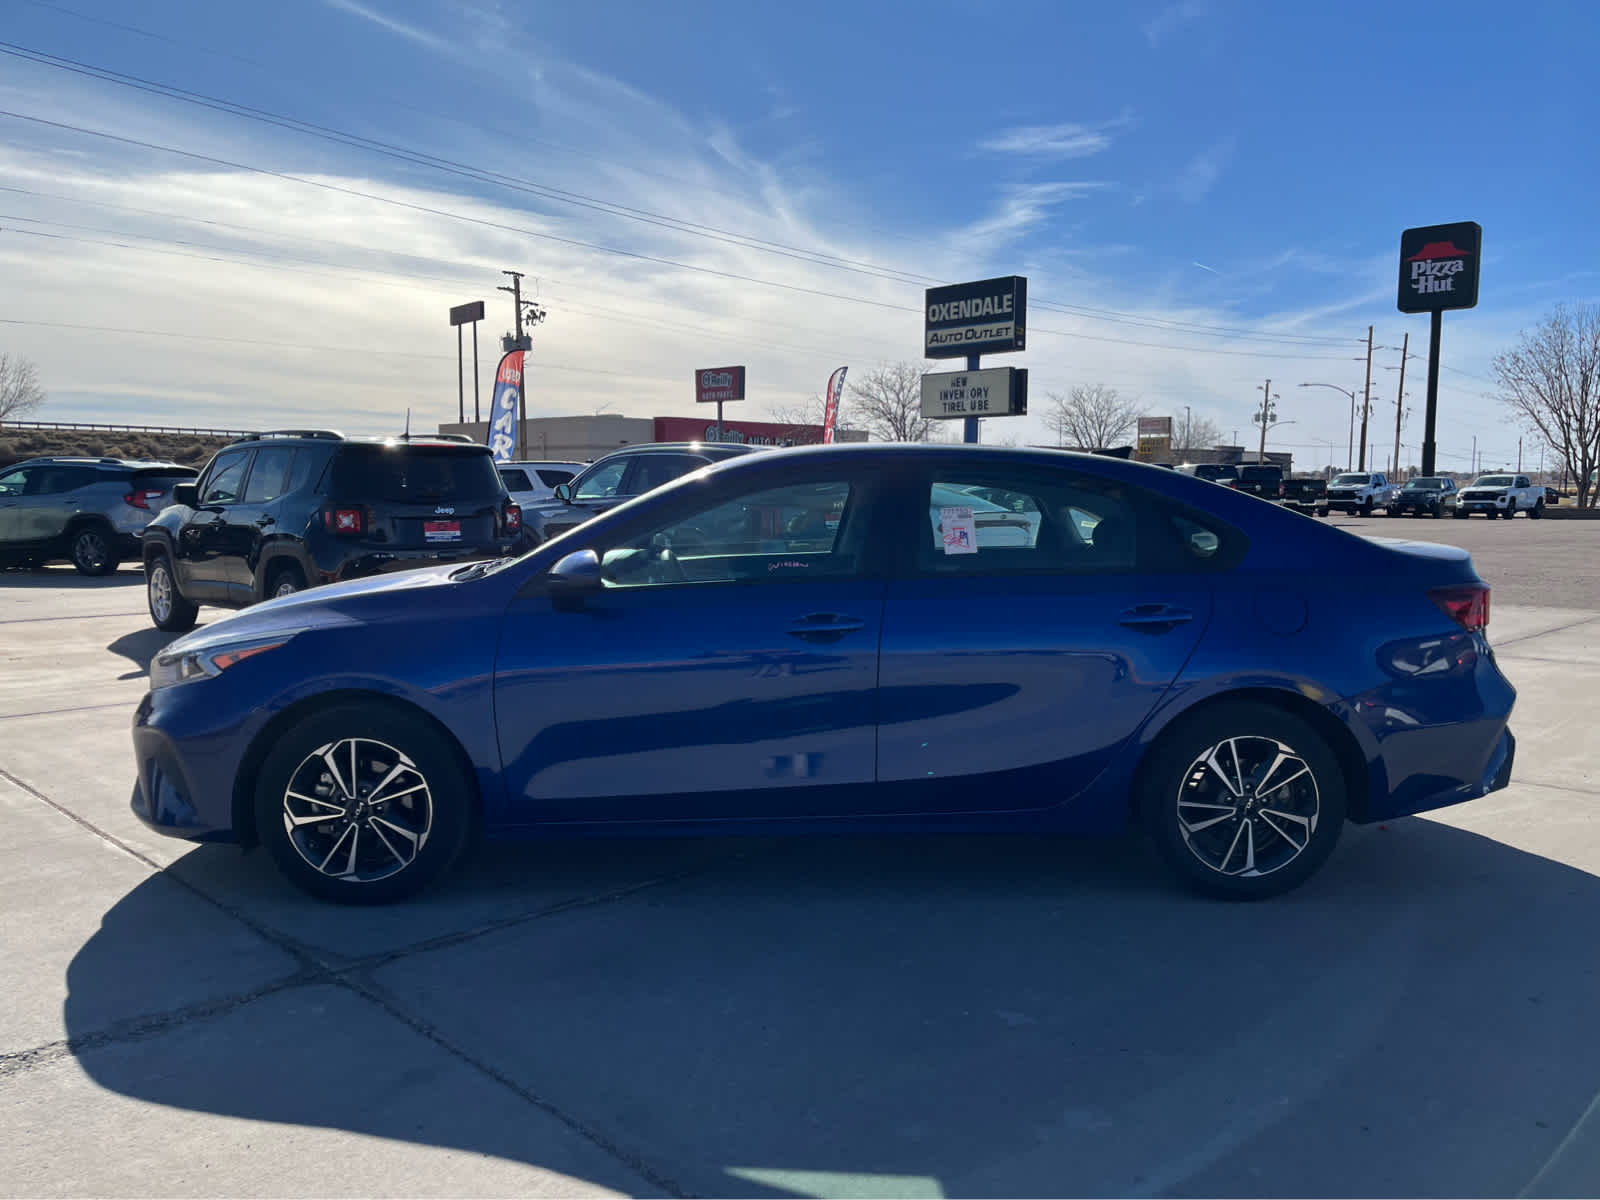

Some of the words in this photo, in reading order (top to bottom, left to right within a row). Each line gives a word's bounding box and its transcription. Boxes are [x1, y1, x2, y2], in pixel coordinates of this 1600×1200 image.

[1411, 259, 1464, 279] Pizza
[1411, 275, 1456, 294] Hut
[928, 294, 1013, 322] OXENDALE
[929, 332, 963, 345] AUTO
[965, 327, 1011, 341] OUTLET
[434, 506, 455, 514] Jeep
